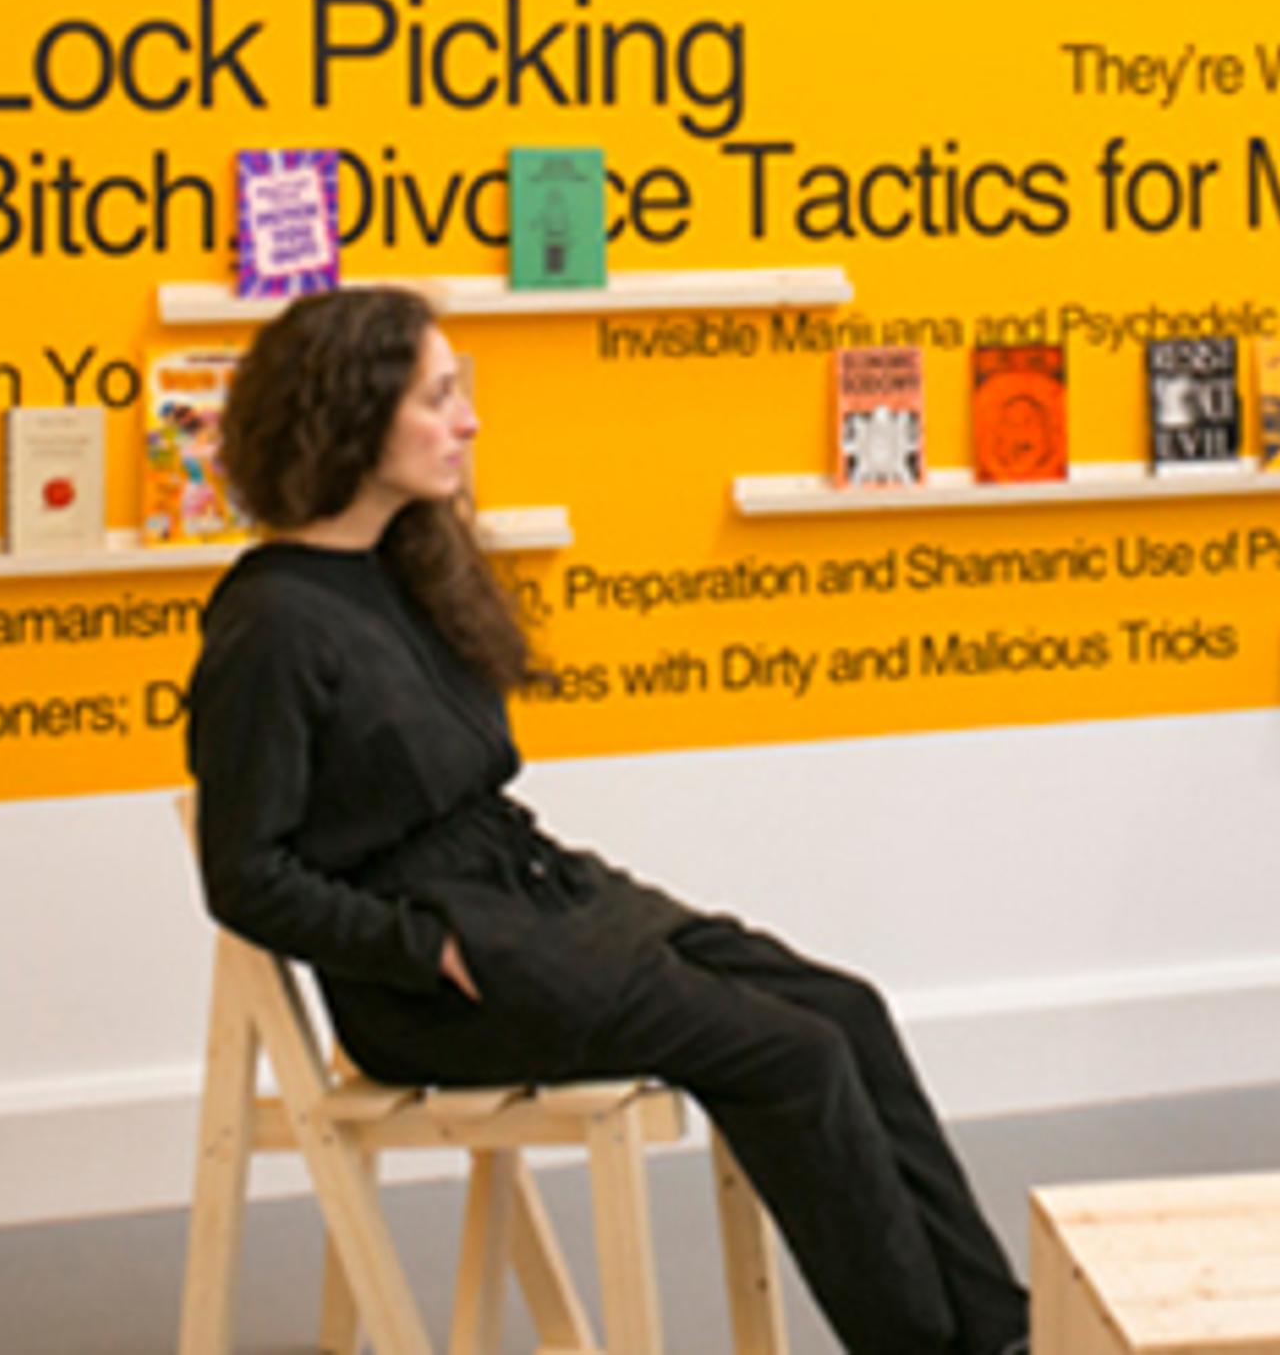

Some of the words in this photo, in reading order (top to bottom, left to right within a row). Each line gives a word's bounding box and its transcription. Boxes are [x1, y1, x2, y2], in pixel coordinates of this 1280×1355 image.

[1060, 45, 1246, 107] They're
[332, 145, 694, 251] Divoce
[719, 138, 1071, 243] Tactics
[1095, 135, 1222, 236] for
[596, 311, 762, 361] Invisible
[972, 307, 1050, 347] and
[1058, 300, 1280, 349] Psychedelic
[562, 555, 810, 619] Preparation
[818, 545, 898, 597] and
[904, 540, 1110, 593] Shamanic
[1116, 535, 1194, 581] Use
[1202, 530, 1242, 575] of
[622, 649, 712, 701] with
[720, 643, 824, 701] Dirty
[828, 637, 912, 689] and
[918, 625, 1114, 679] Malicious
[1122, 619, 1240, 665] Tricks
